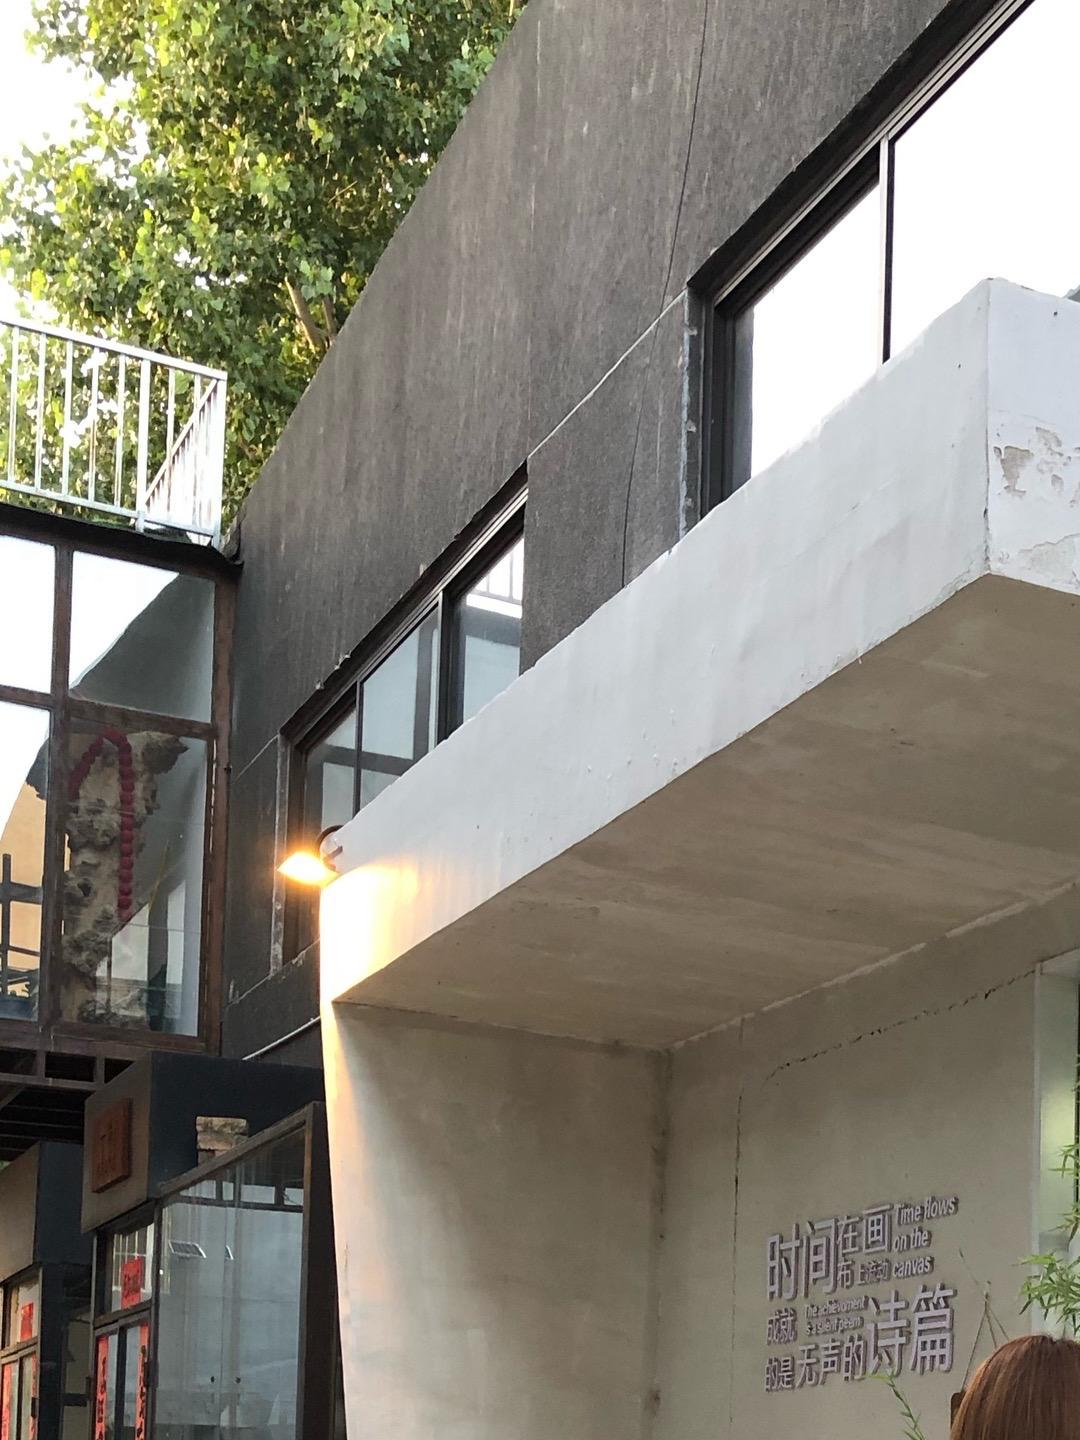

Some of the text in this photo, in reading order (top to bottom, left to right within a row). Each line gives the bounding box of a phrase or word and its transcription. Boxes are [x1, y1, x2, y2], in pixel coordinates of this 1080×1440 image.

[894, 1197, 959, 1225] Time flows
[892, 1227, 932, 1252] on the
[892, 1255, 934, 1278] canvas
[767, 1308, 798, 1346] 成就
